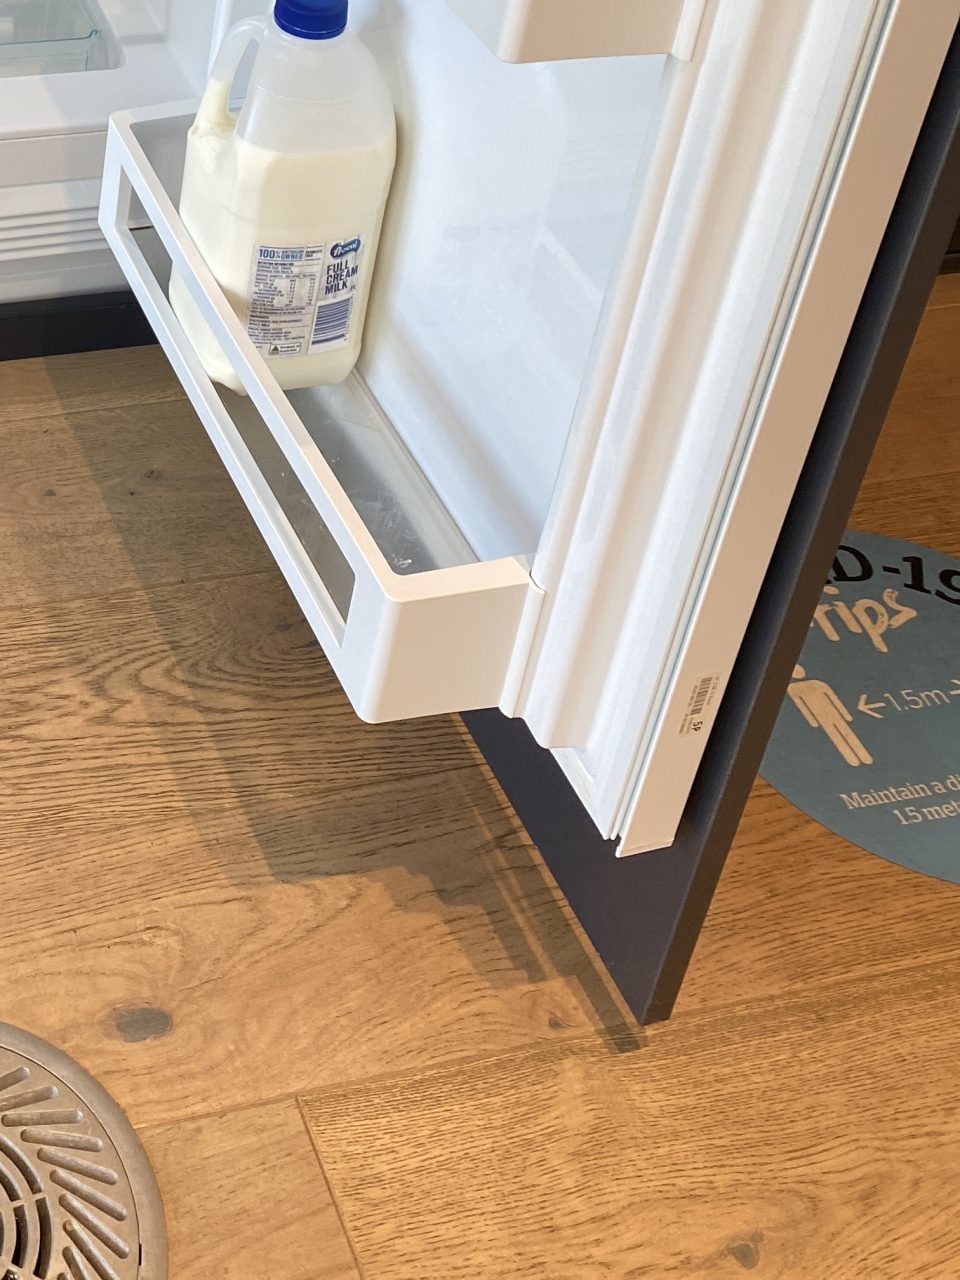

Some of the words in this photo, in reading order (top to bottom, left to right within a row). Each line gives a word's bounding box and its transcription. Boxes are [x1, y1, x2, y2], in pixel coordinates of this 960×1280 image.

[259, 249, 281, 259] 100%
[326, 259, 350, 276] FULL
[326, 264, 359, 285] CREAM
[324, 280, 348, 296] MILK
[810, 586, 917, 653] rips
[883, 689, 951, 712] 1.5m
[839, 782, 933, 810] Maintain
[930, 781, 948, 794] a
